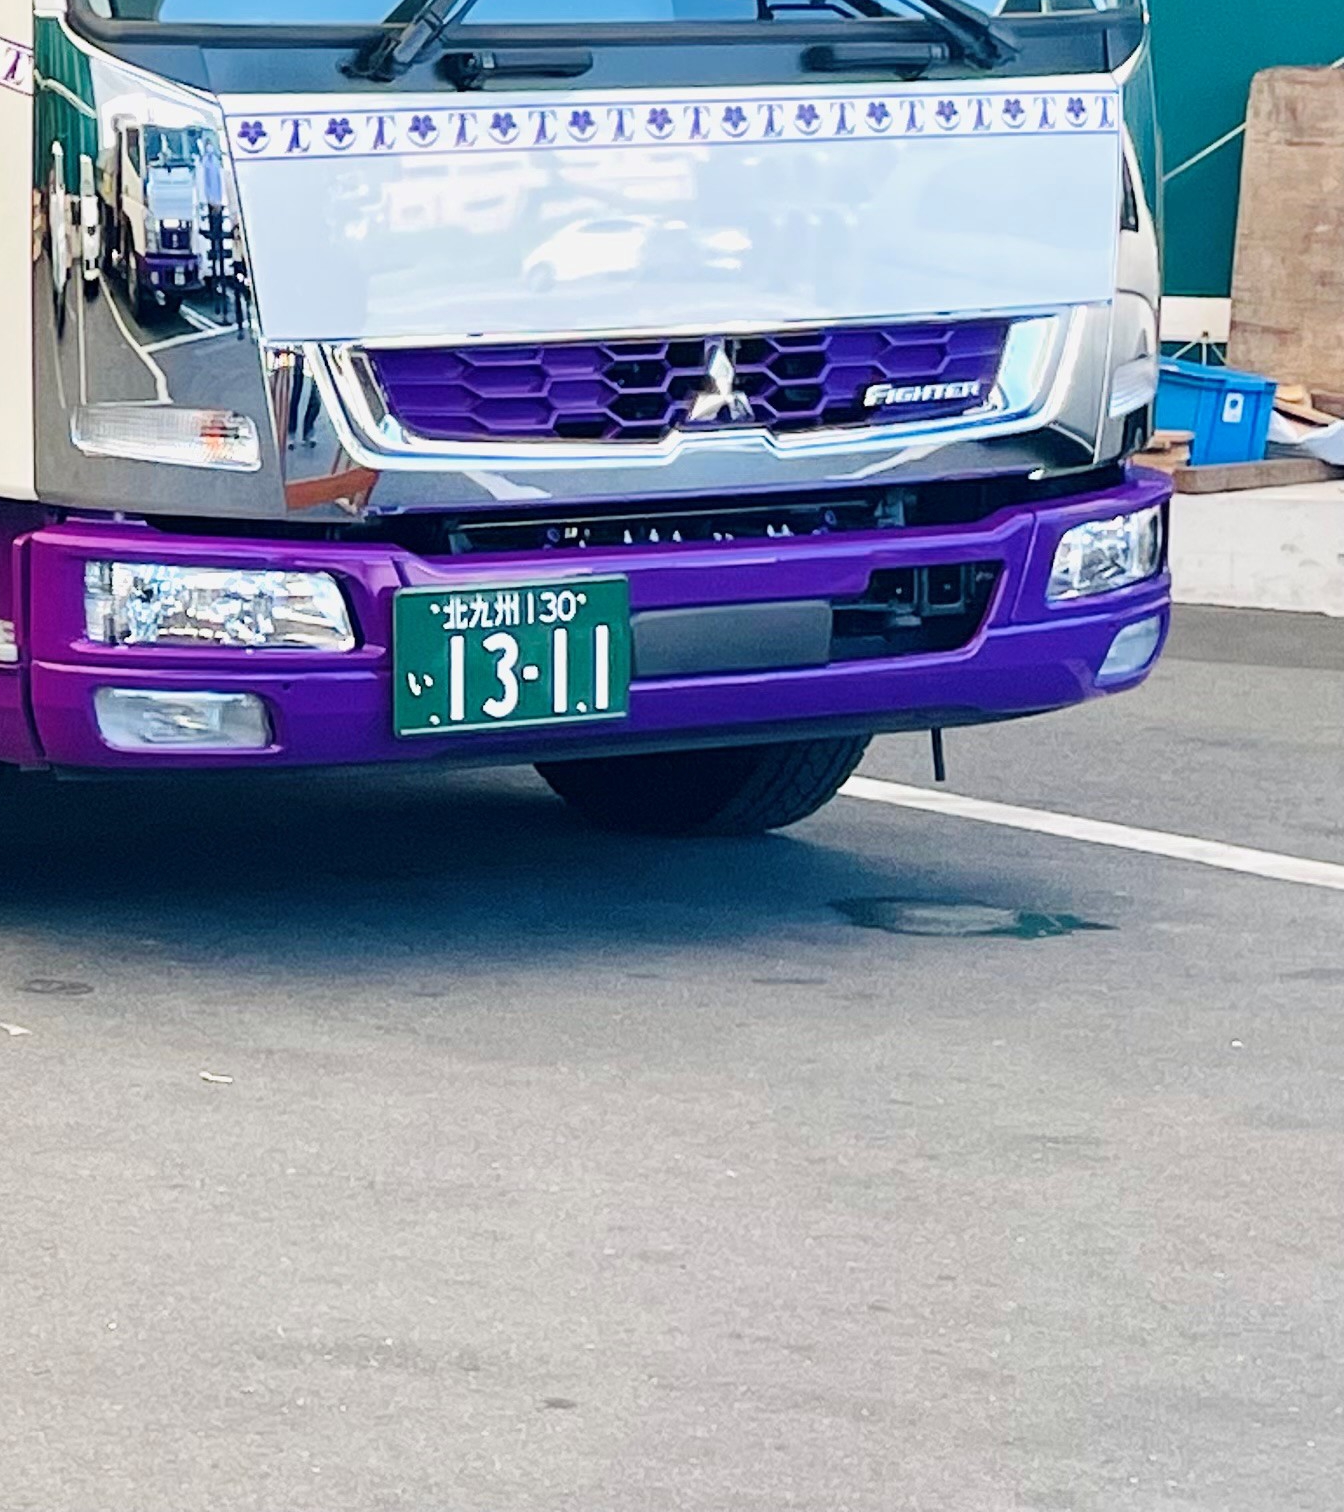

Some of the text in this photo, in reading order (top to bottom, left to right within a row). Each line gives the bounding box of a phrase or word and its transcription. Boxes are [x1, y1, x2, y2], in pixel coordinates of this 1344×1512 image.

[863, 380, 981, 407] FIGHTER
[443, 590, 577, 630] 北九州 130
[407, 671, 434, 696] い
